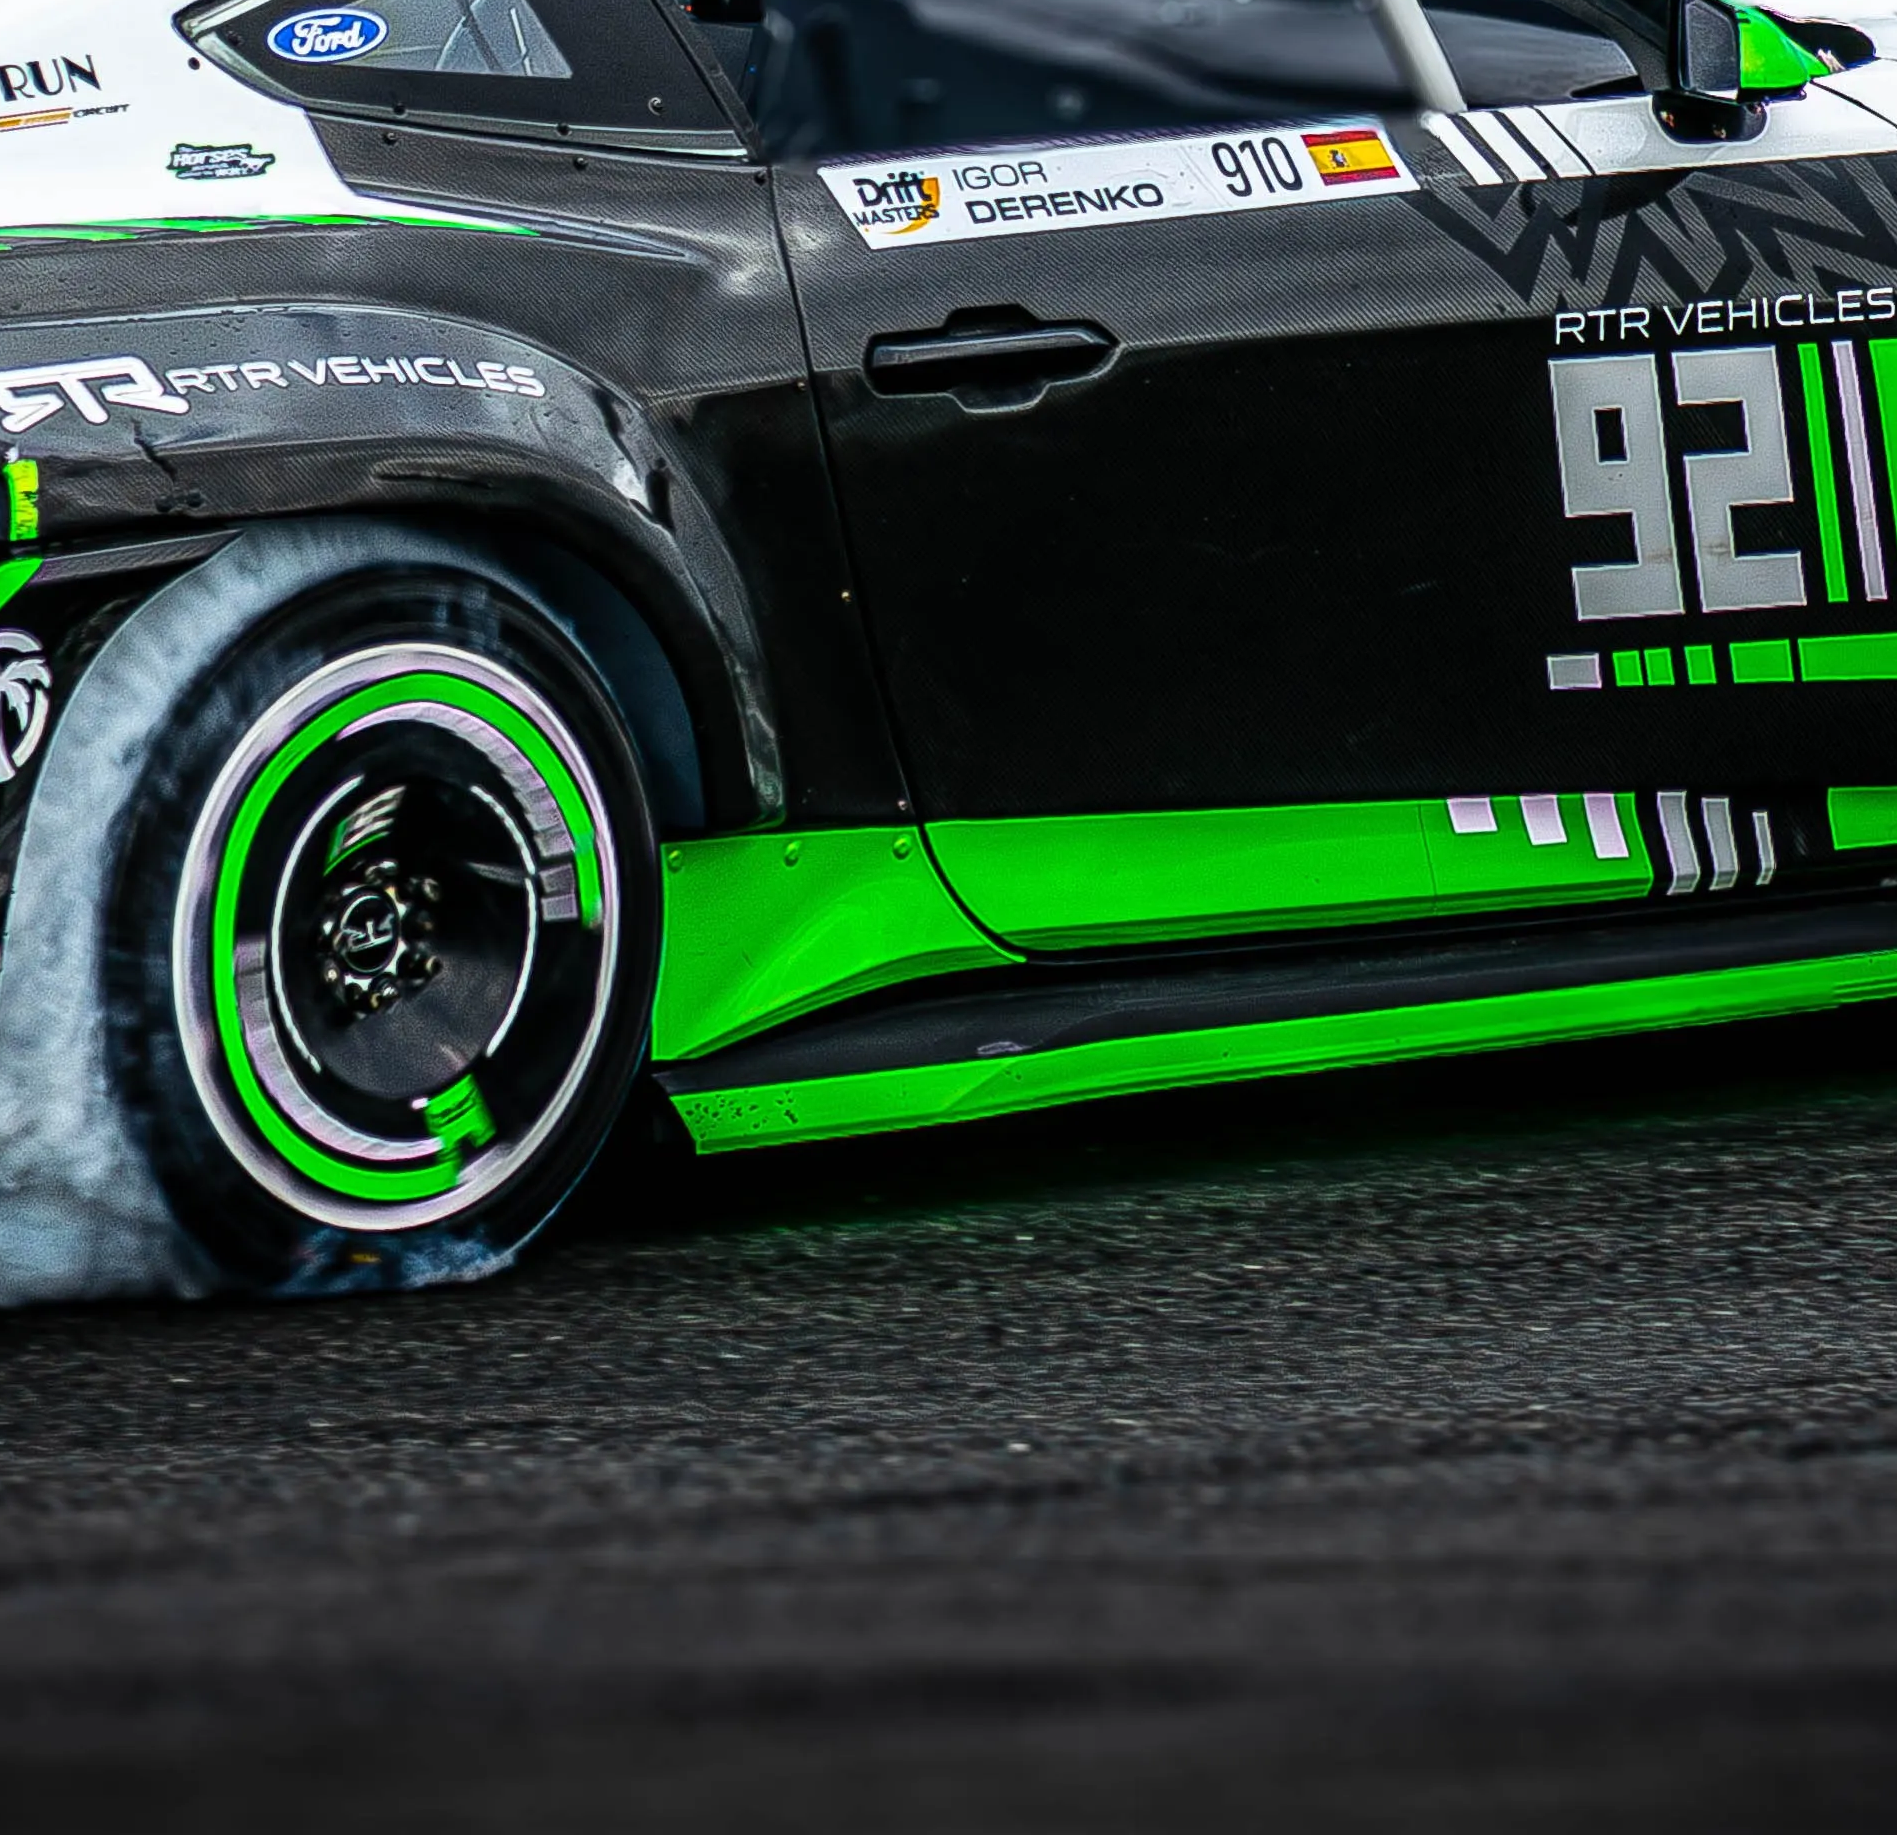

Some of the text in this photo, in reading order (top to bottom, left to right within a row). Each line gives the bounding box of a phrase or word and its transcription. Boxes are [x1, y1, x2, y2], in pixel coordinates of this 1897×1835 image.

[292, 16, 366, 55] Ford
[852, 170, 933, 207] Drift
[950, 160, 1049, 193] IGOR
[1210, 135, 1303, 199] 910
[852, 202, 941, 227] MASTERS
[963, 182, 1166, 225] DERENKO
[1555, 286, 1896, 346] RTR VEHICLES
[166, 361, 289, 396] RTR
[288, 355, 547, 399] VEHICLES
[1548, 344, 1808, 621] 92
